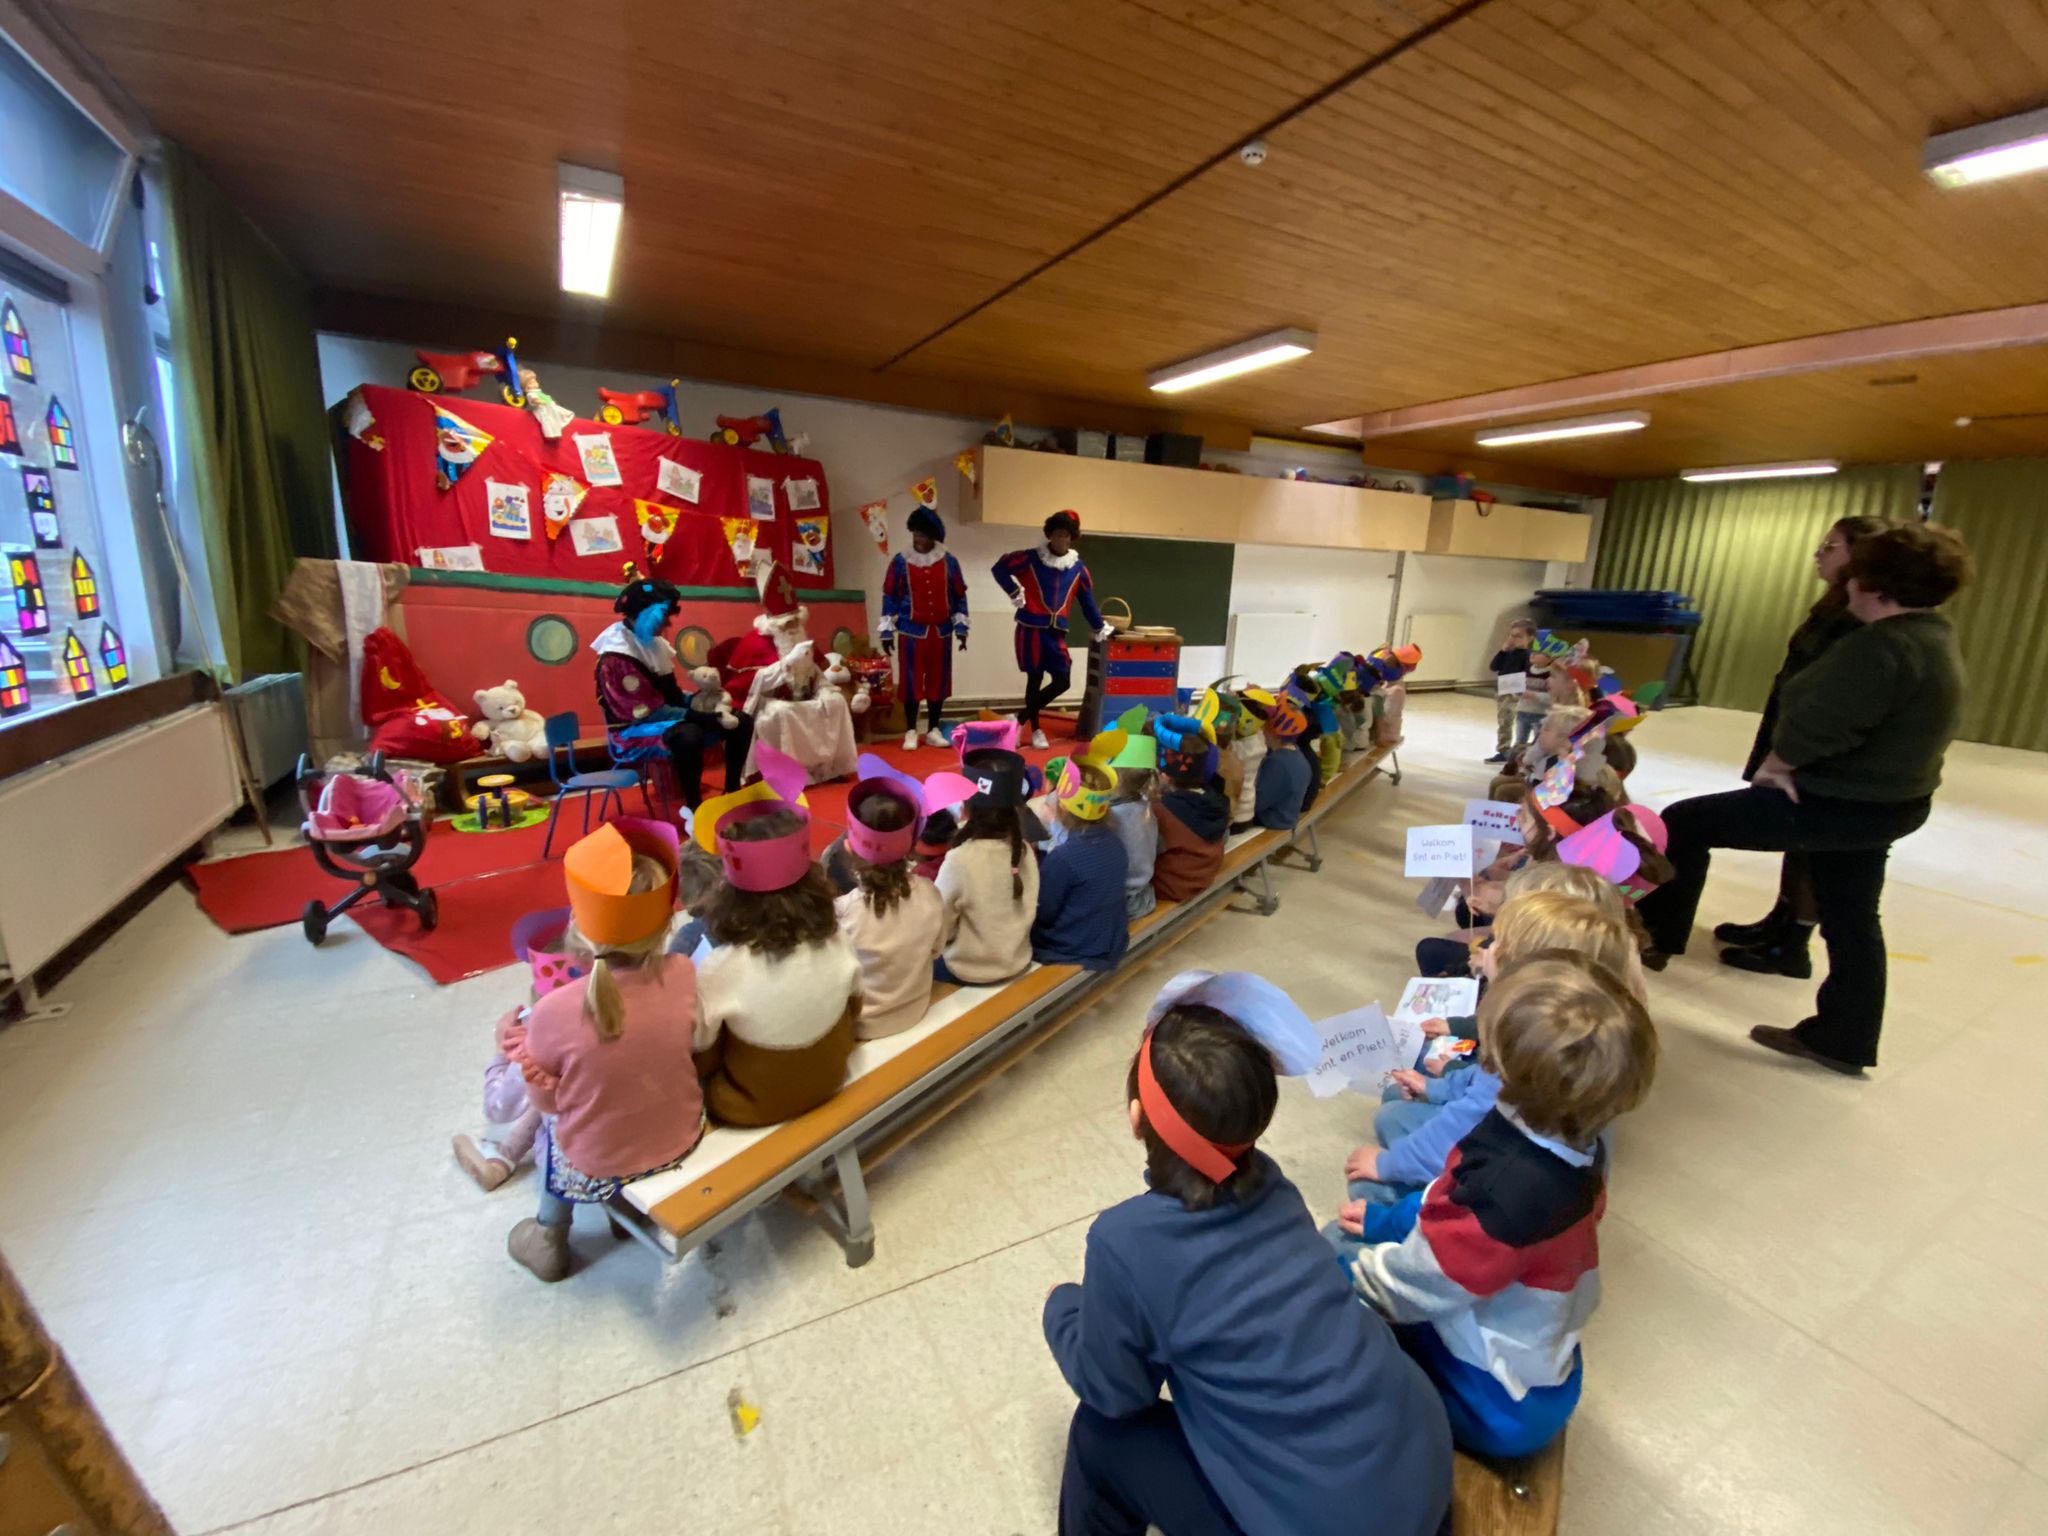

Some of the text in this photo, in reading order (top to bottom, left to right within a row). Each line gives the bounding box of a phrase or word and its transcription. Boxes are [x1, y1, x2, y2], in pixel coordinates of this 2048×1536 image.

[1315, 1038, 1386, 1075] Sint en Piet!
